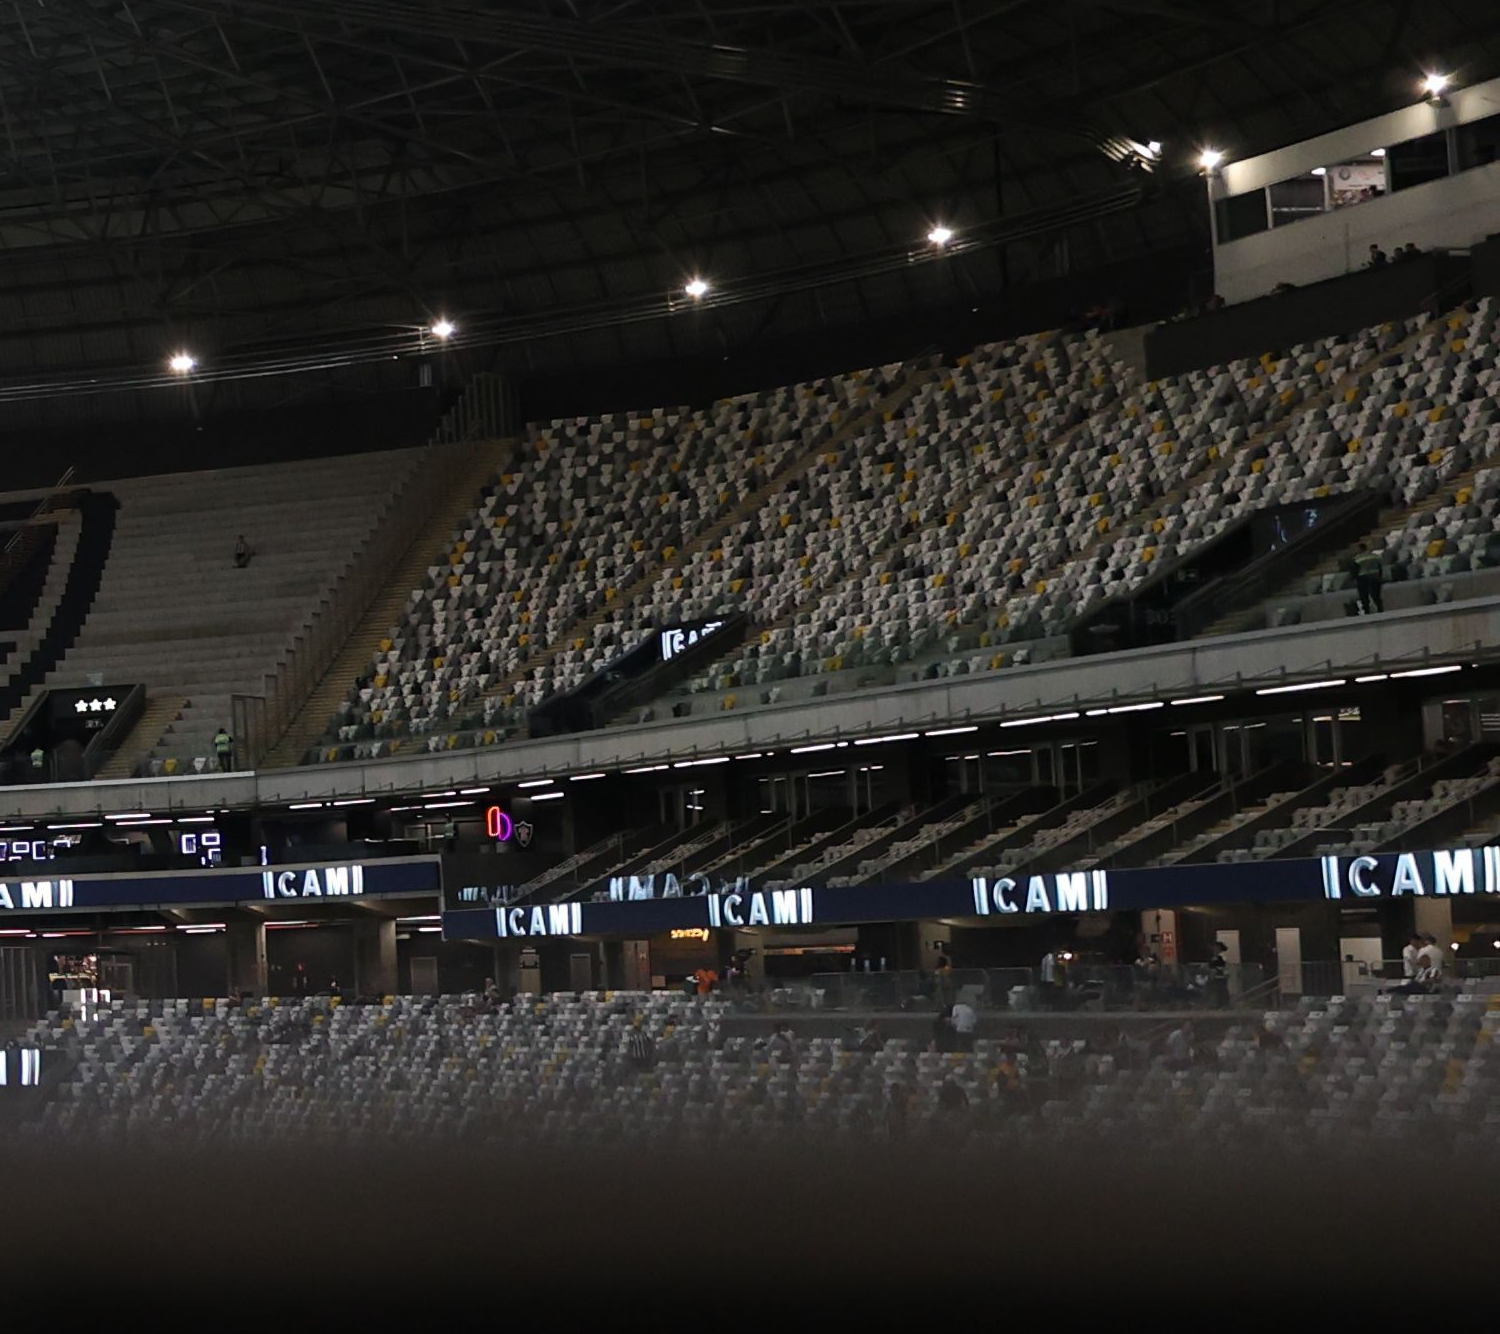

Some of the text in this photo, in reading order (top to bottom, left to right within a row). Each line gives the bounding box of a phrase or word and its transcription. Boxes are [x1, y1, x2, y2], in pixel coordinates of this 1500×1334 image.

[994, 872, 1087, 912] CAM
[1349, 849, 1474, 895] CAM
[724, 890, 797, 925] CAM
